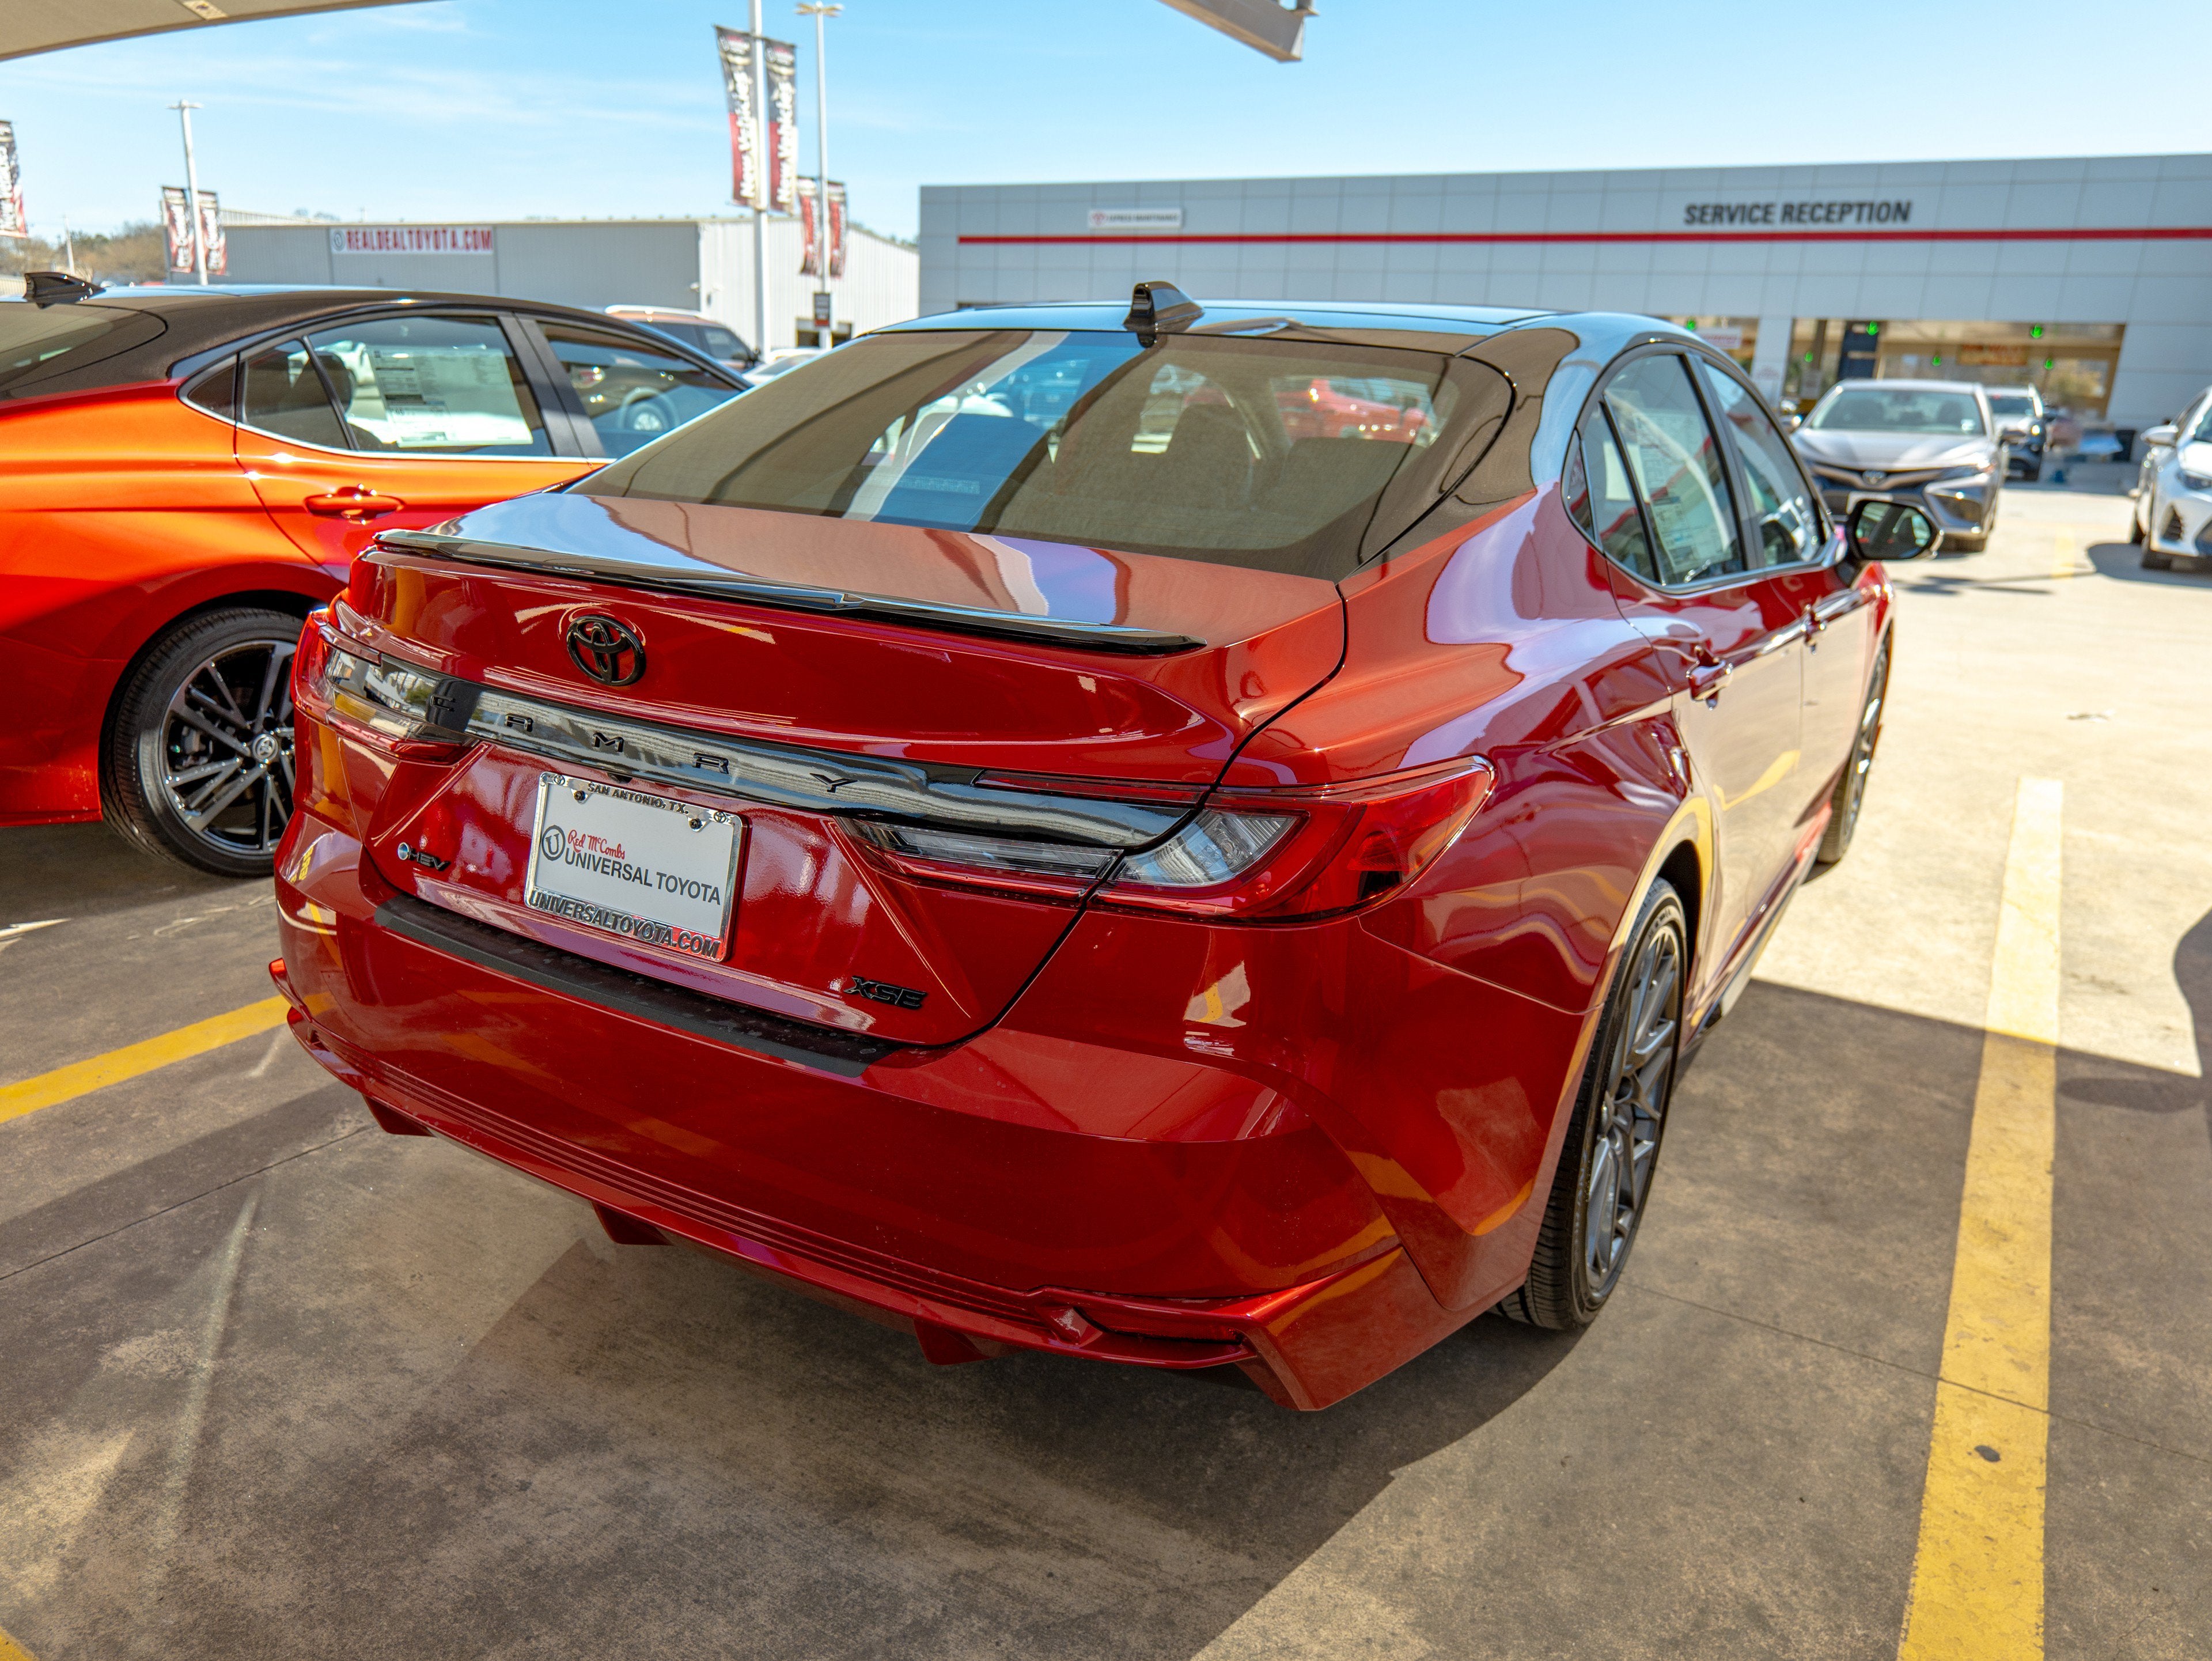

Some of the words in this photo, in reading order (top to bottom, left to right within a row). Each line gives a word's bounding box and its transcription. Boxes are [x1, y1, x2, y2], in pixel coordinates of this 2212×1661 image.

[1684, 202, 1775, 225] SERVICE
[1781, 200, 1912, 223] RECEPTION
[347, 229, 493, 251] REALDEALTOYOTA.COM
[430, 694, 858, 793] CAMRY
[588, 782, 611, 797] SAN
[612, 789, 666, 809] ANTONIO,
[669, 800, 690, 814] TX.
[567, 829, 586, 853] Red
[587, 834, 626, 860] McCombs
[565, 847, 653, 888] UNIVERSAL
[656, 871, 721, 906] TOYOTA
[529, 891, 721, 960] UNIVERSALTOYOTA.COM
[843, 975, 929, 1010] XSE
